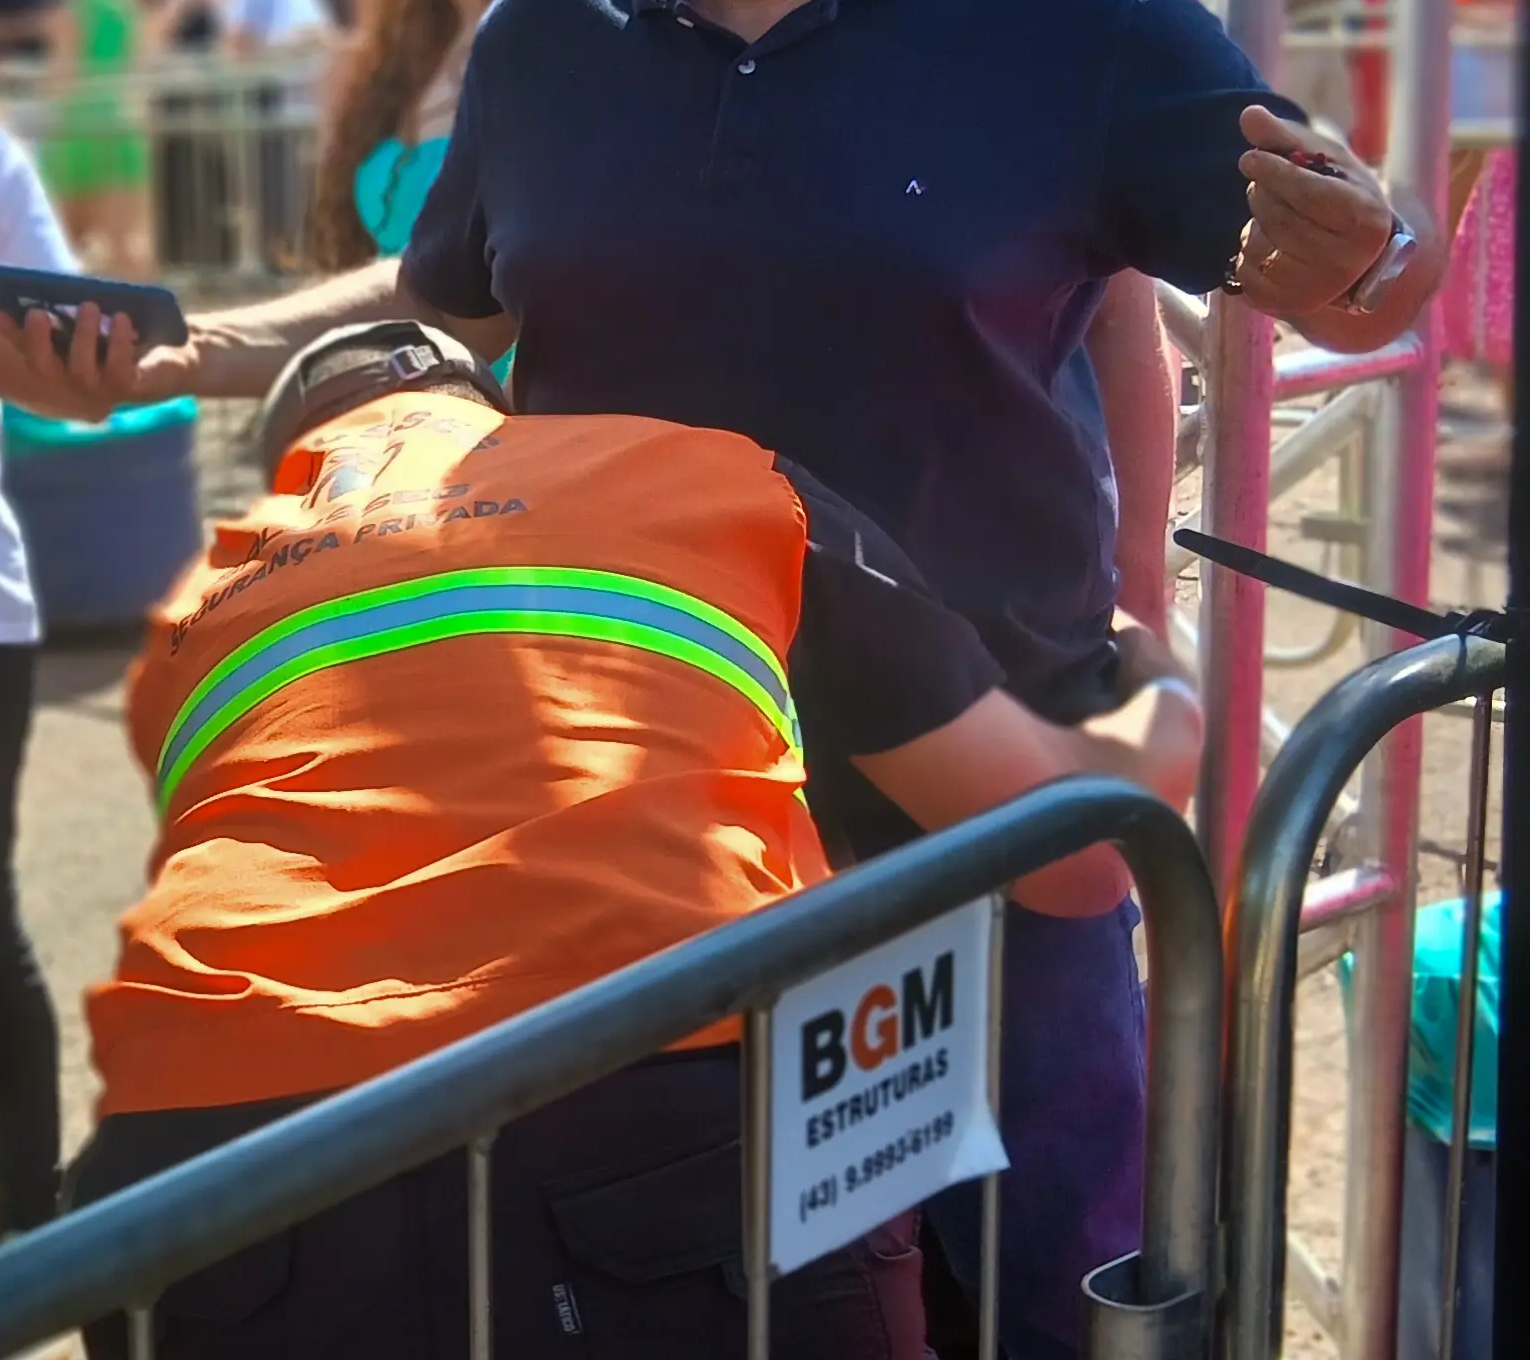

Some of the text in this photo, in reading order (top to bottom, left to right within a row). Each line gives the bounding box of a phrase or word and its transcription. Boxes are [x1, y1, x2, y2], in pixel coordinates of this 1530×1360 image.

[353, 498, 528, 545] PRIVADA
[801, 950, 954, 1103] BGM
[806, 1048, 949, 1149] ESTRUTURAS
[799, 1173, 838, 1224] (43)
